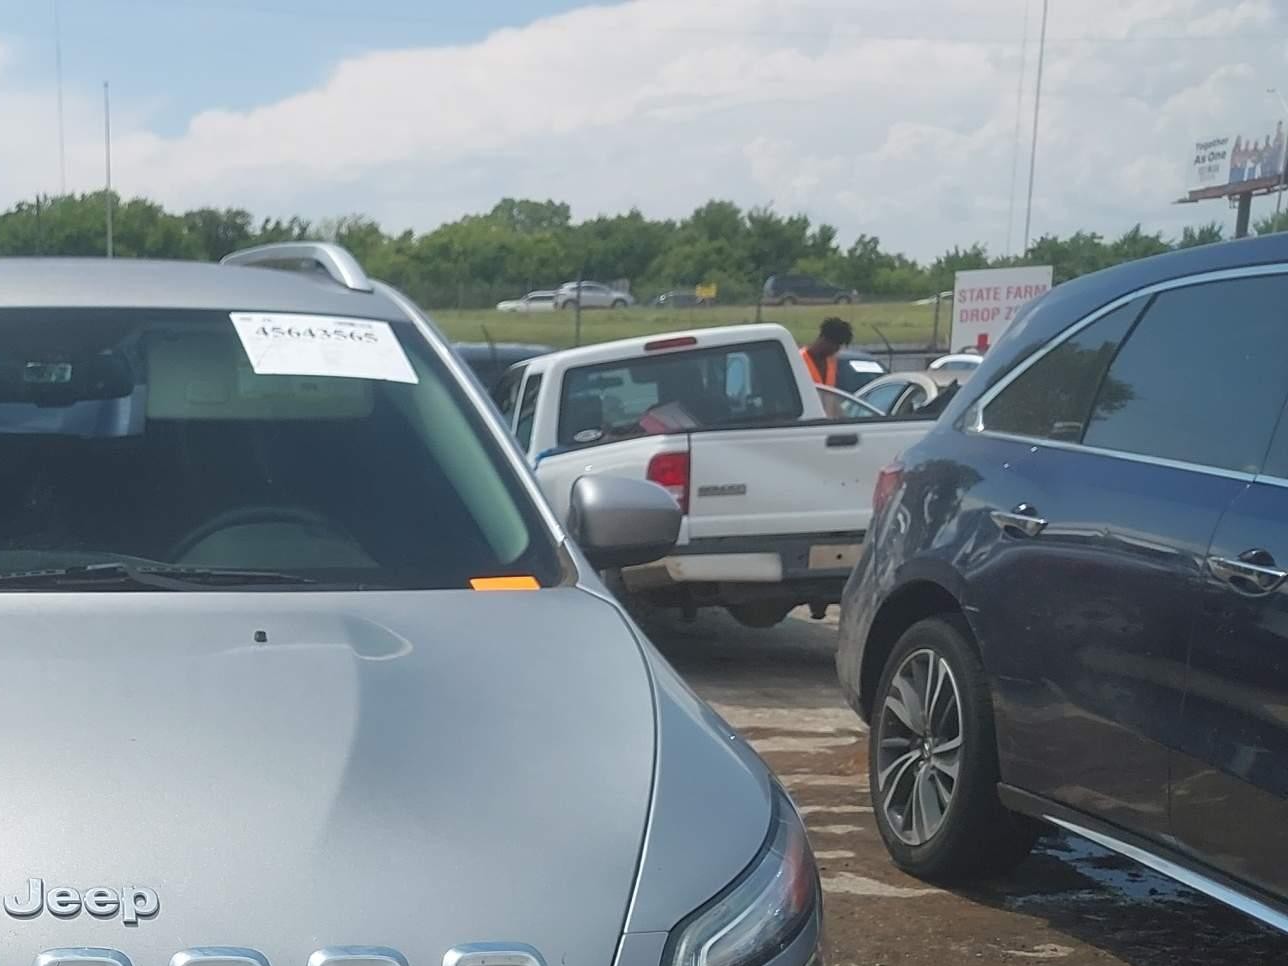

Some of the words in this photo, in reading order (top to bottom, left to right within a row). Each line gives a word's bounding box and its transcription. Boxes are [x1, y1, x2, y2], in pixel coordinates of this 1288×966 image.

[958, 286, 1002, 304] STATE
[1005, 284, 1048, 301] FARM
[959, 307, 1001, 323] DROP
[255, 326, 379, 345] 45643565
[3, 877, 161, 926] Jeep
